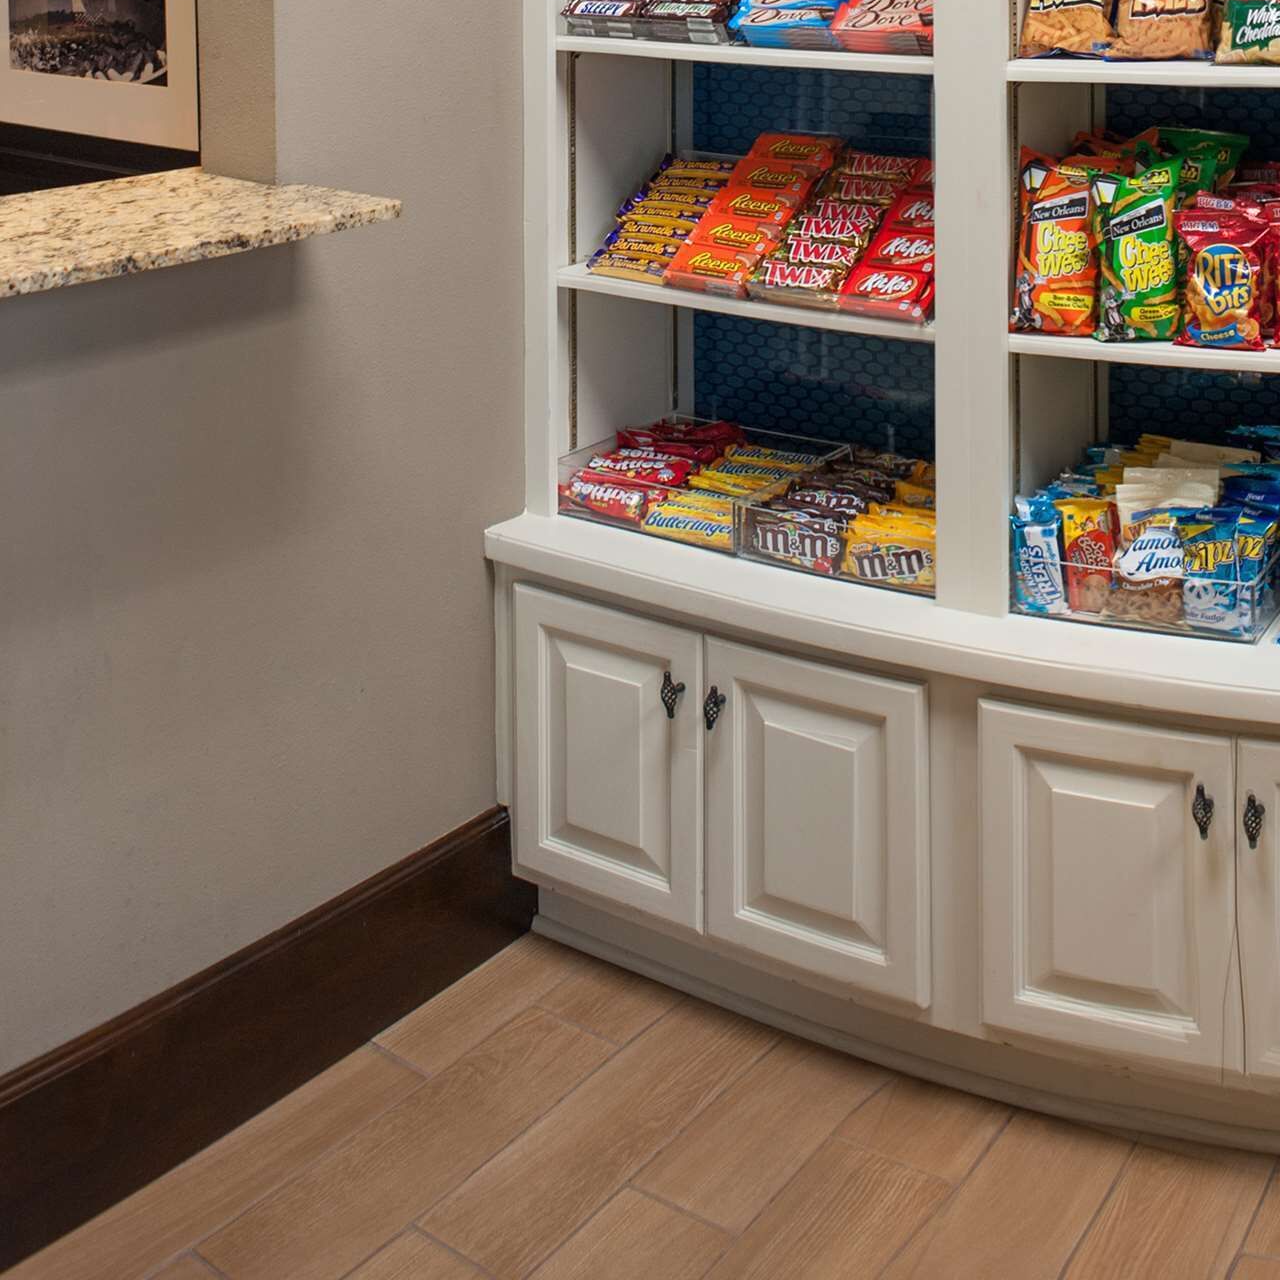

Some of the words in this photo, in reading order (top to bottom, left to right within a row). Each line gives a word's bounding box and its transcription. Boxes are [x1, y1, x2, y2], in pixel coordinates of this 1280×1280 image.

[580, 2, 624, 15] SLEEPY
[751, 8, 812, 24] Dove
[852, 11, 913, 27] Dove
[1034, 209, 1050, 220] New
[1052, 205, 1085, 218] Orleans
[1112, 223, 1130, 236] New
[1131, 214, 1163, 230] Orleans
[883, 237, 935, 258] KitKat
[1038, 222, 1088, 254] Chee
[1119, 235, 1170, 269] Chee
[860, 272, 914, 294] KitKat
[1197, 253, 1250, 291] RITZ
[1211, 285, 1251, 315] bits
[1200, 329, 1235, 341] Cheese
[1029, 545, 1061, 601] TREATS
